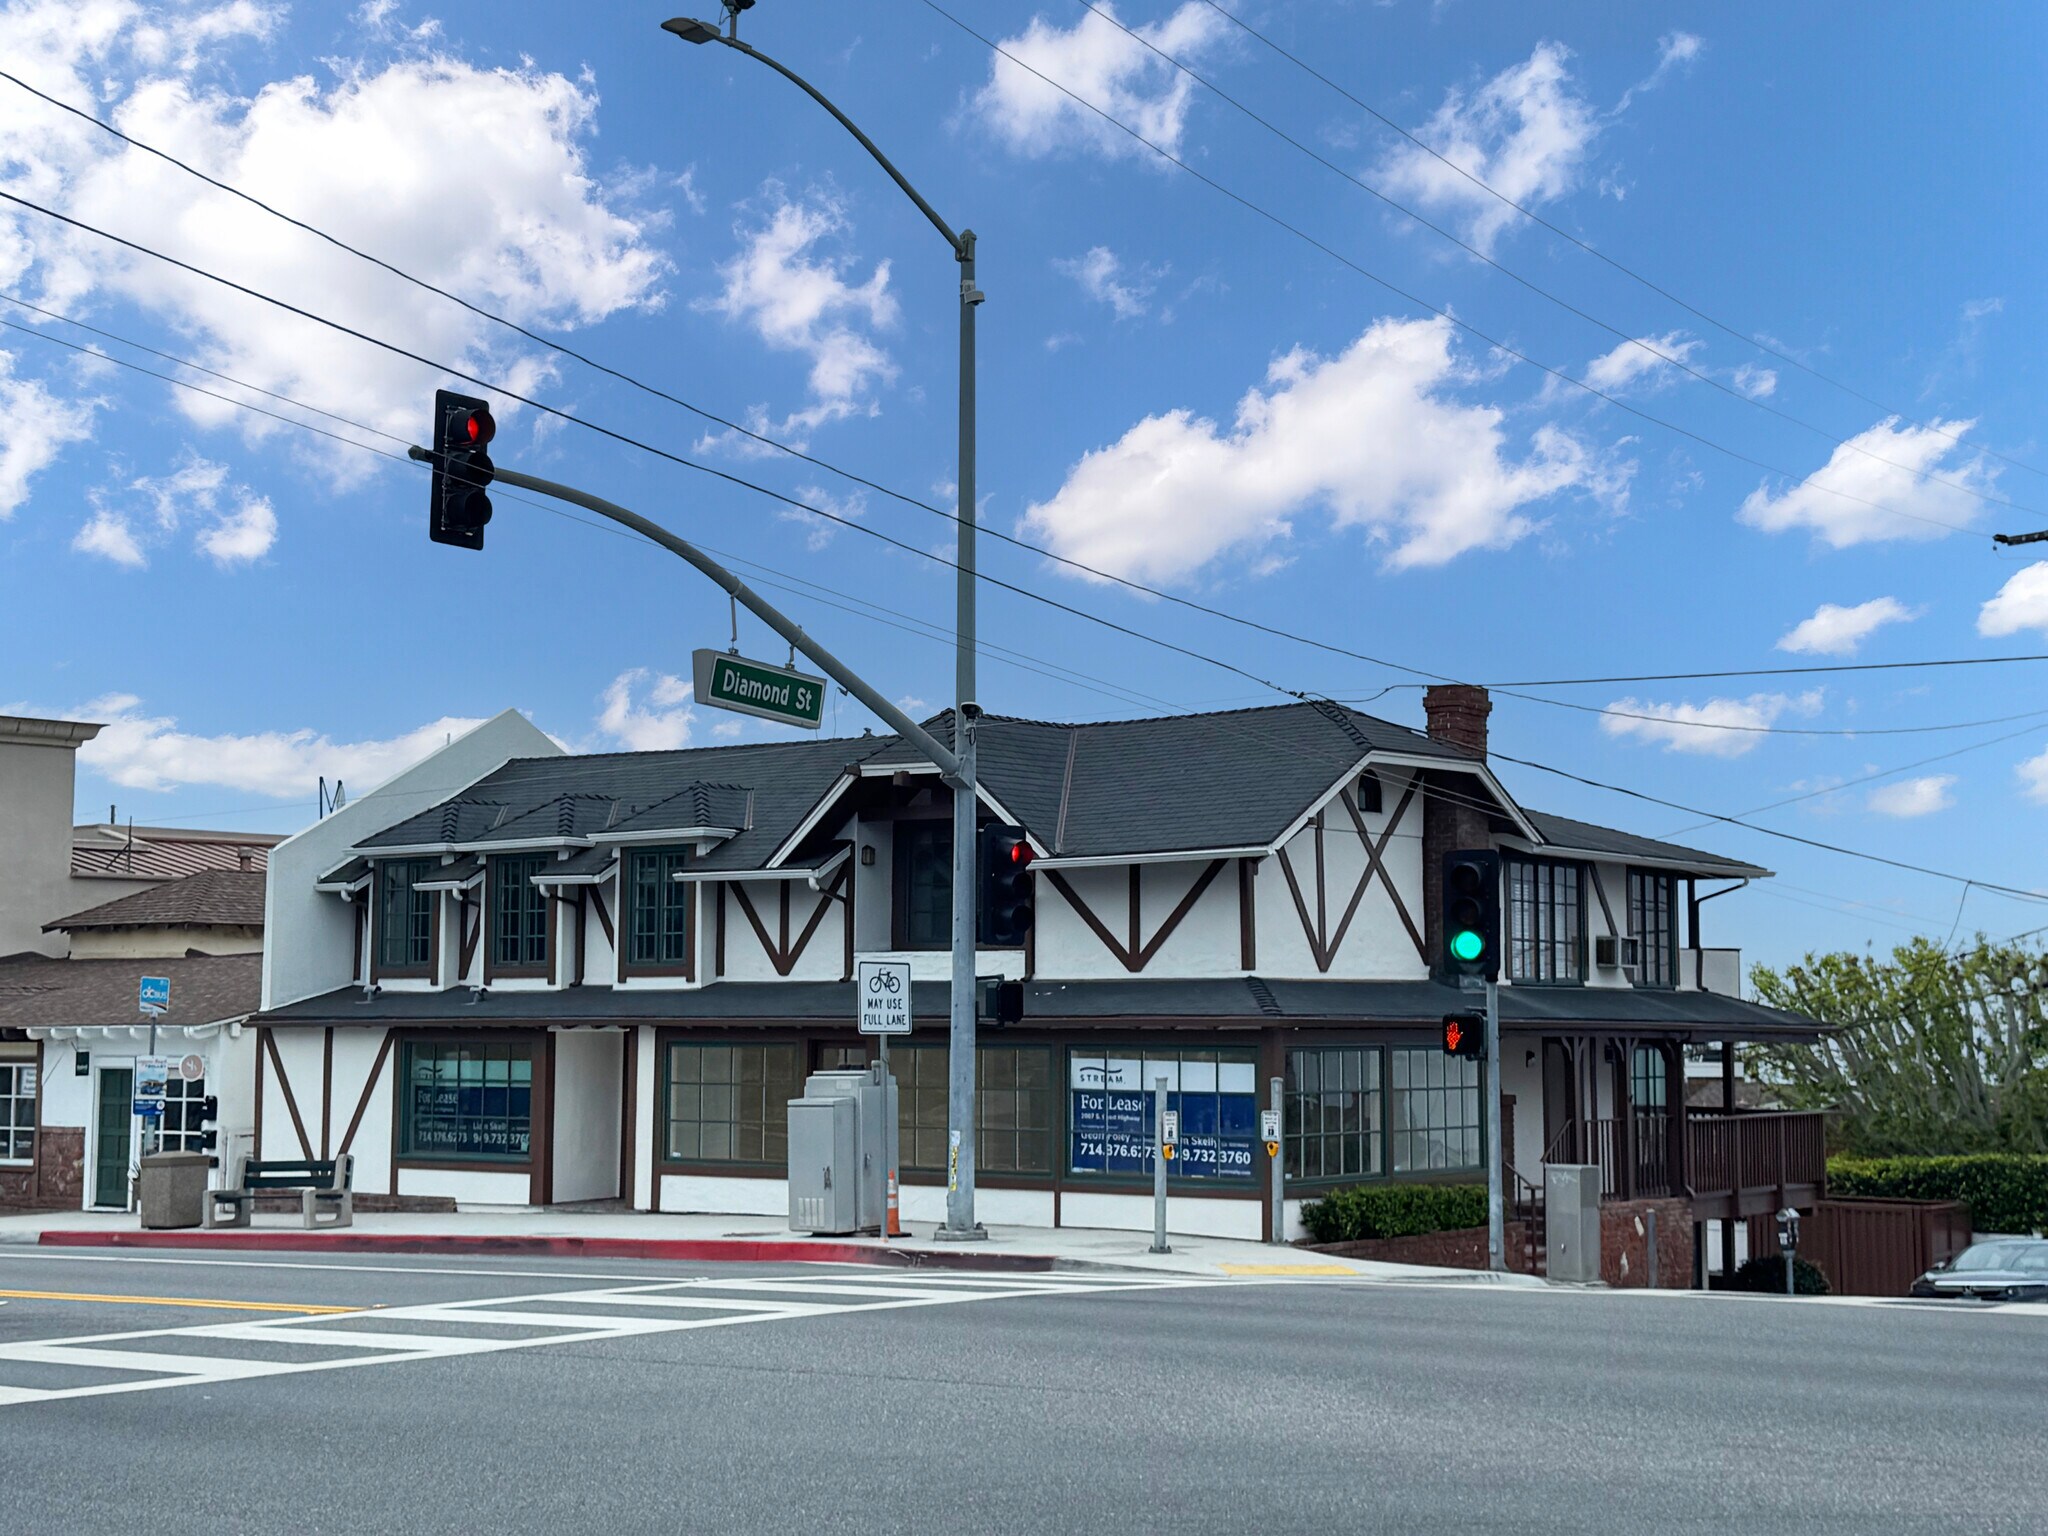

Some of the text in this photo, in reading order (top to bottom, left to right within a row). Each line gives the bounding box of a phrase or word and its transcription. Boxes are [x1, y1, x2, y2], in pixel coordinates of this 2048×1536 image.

[723, 668, 812, 711] Diamond St
[867, 998, 902, 1010] MAY USE
[864, 1014, 906, 1025] FULL LANE
[1081, 1094, 1104, 1110] For
